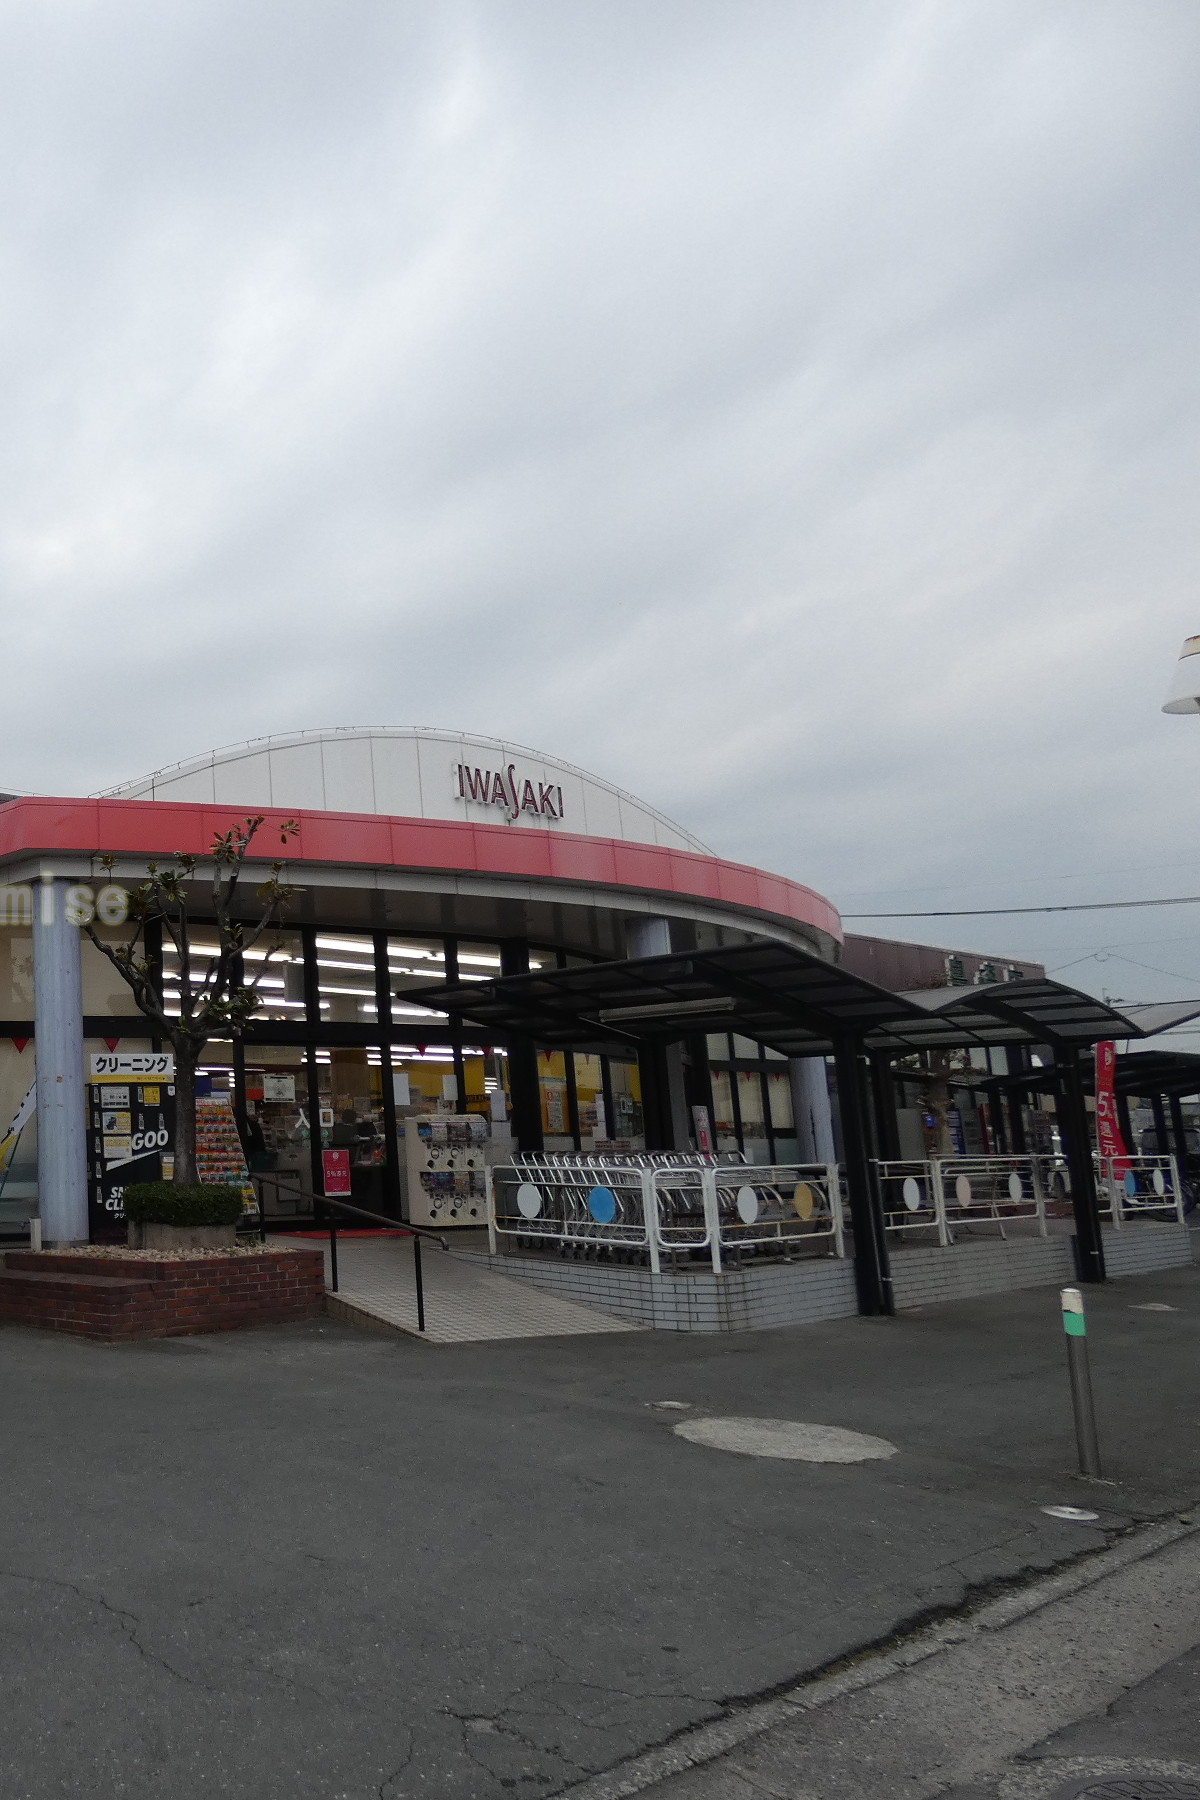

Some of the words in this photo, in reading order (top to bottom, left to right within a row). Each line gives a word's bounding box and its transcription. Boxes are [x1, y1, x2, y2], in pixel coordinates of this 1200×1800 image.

[457, 764, 564, 819] IWASAKI
[95, 1057, 169, 1073] クリーニング
[295, 1108, 334, 1128] 入口
[132, 1129, 169, 1151] GOO
